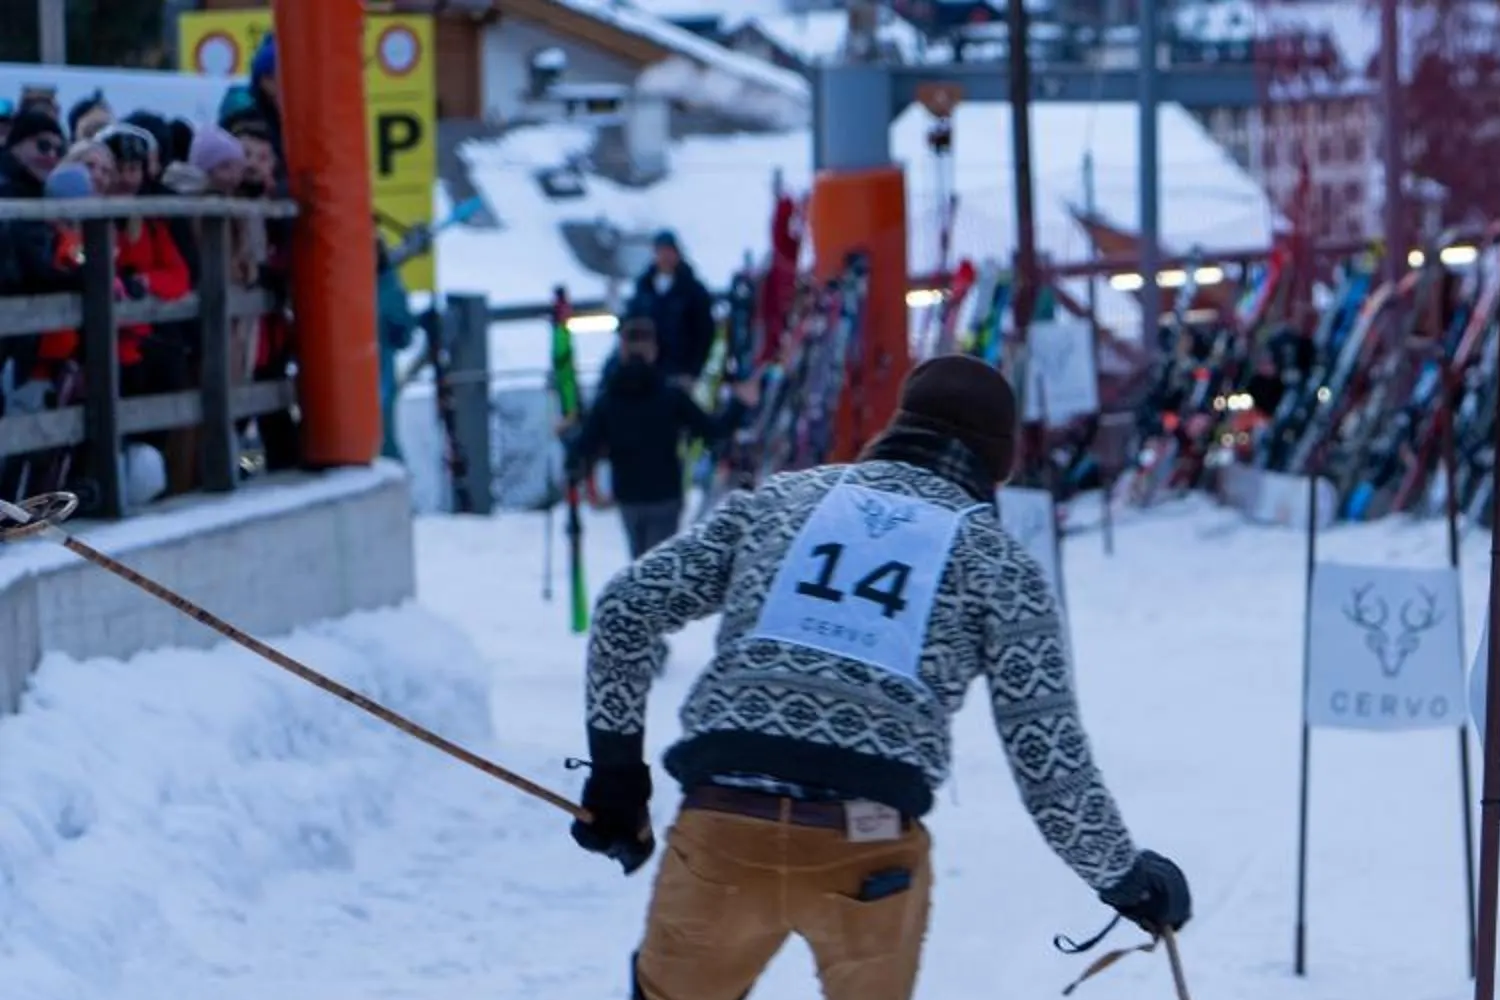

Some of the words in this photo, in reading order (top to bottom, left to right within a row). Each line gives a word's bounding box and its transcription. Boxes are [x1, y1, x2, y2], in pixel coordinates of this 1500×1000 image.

[376, 113, 422, 176] P
[796, 542, 912, 618] 14
[1330, 690, 1449, 719] CERVO
